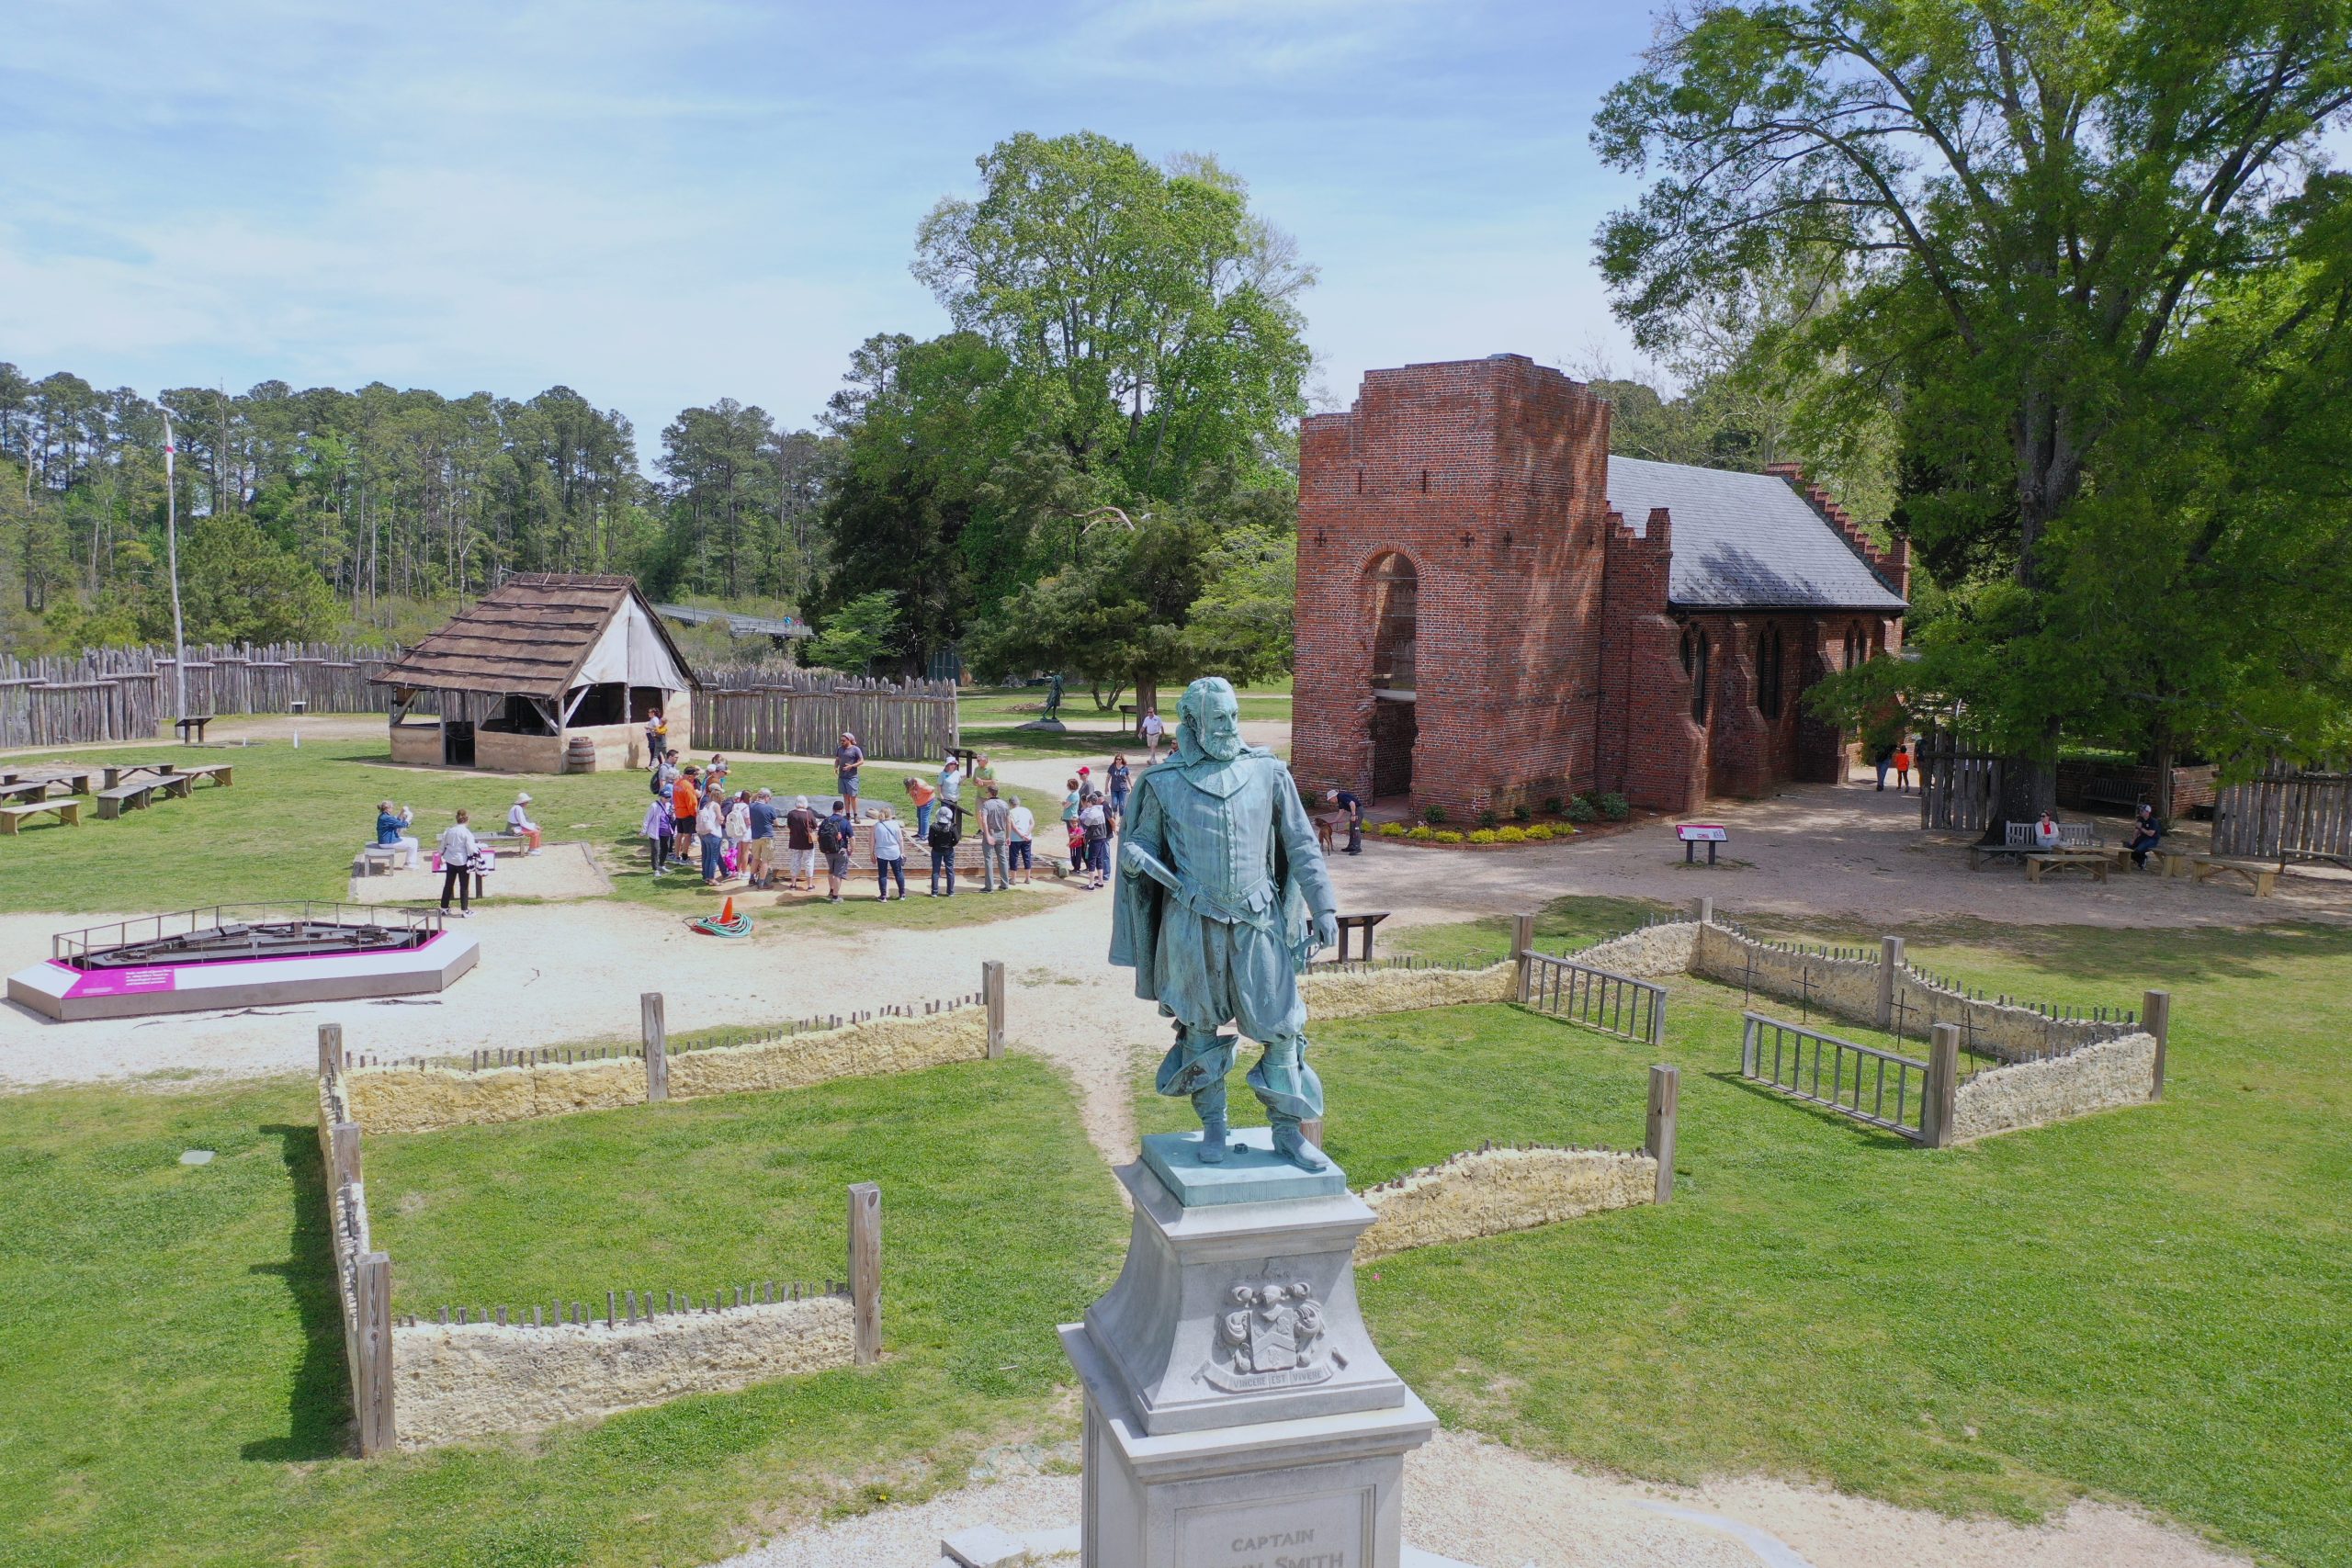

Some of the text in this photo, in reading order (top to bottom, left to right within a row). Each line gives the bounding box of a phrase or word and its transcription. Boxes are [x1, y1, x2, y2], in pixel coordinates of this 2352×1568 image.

[1234, 1369, 1322, 1388] VINCERE EST VIVERE
[1231, 1529, 1315, 1551] CAPTAIN
